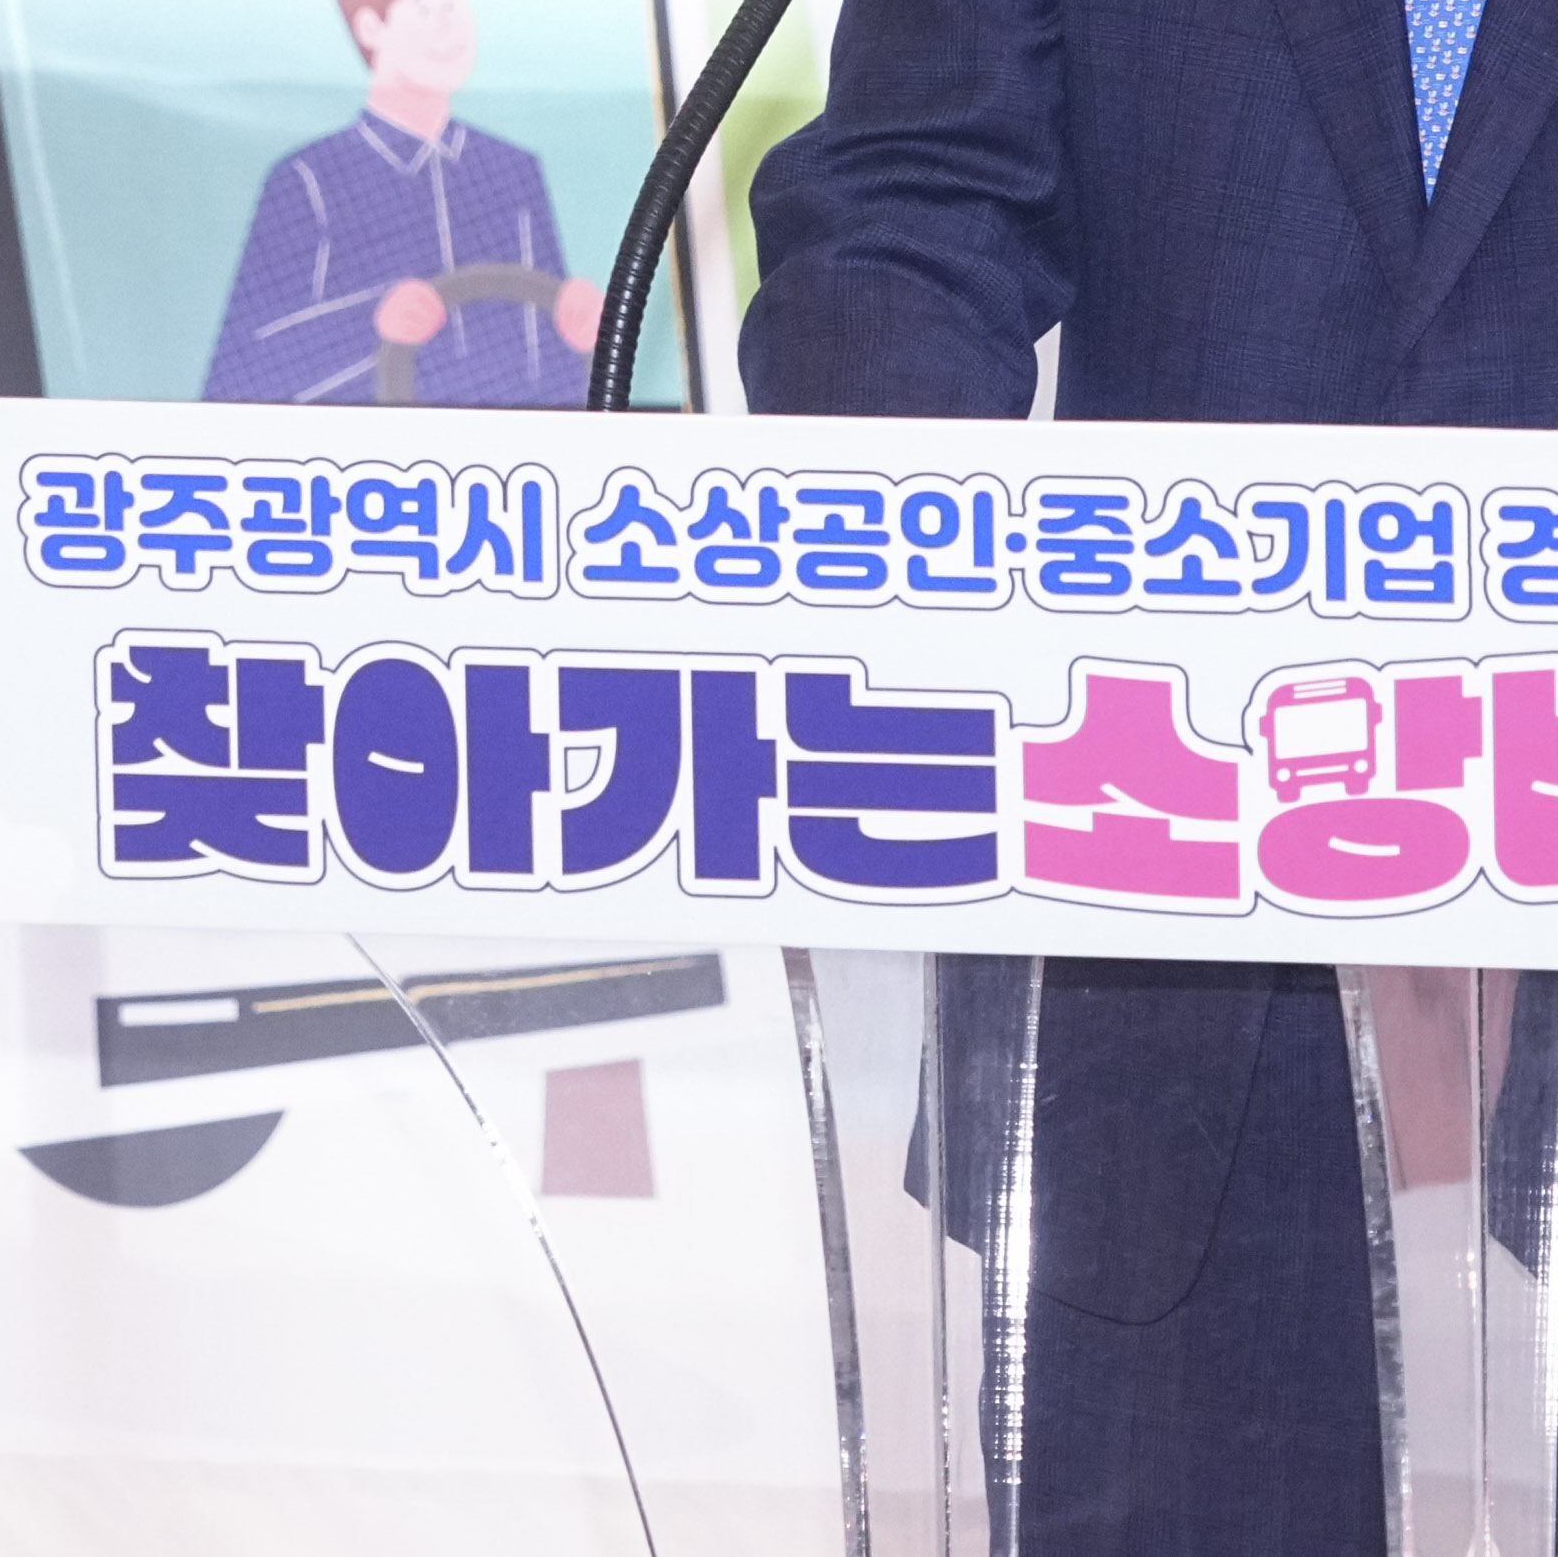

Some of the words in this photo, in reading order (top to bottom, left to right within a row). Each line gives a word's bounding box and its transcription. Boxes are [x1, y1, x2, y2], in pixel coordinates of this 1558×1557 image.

[35, 471, 544, 581] 광주광역시
[584, 484, 1455, 603] 소상공인·중소기업
[112, 645, 997, 888] 찾아가는
